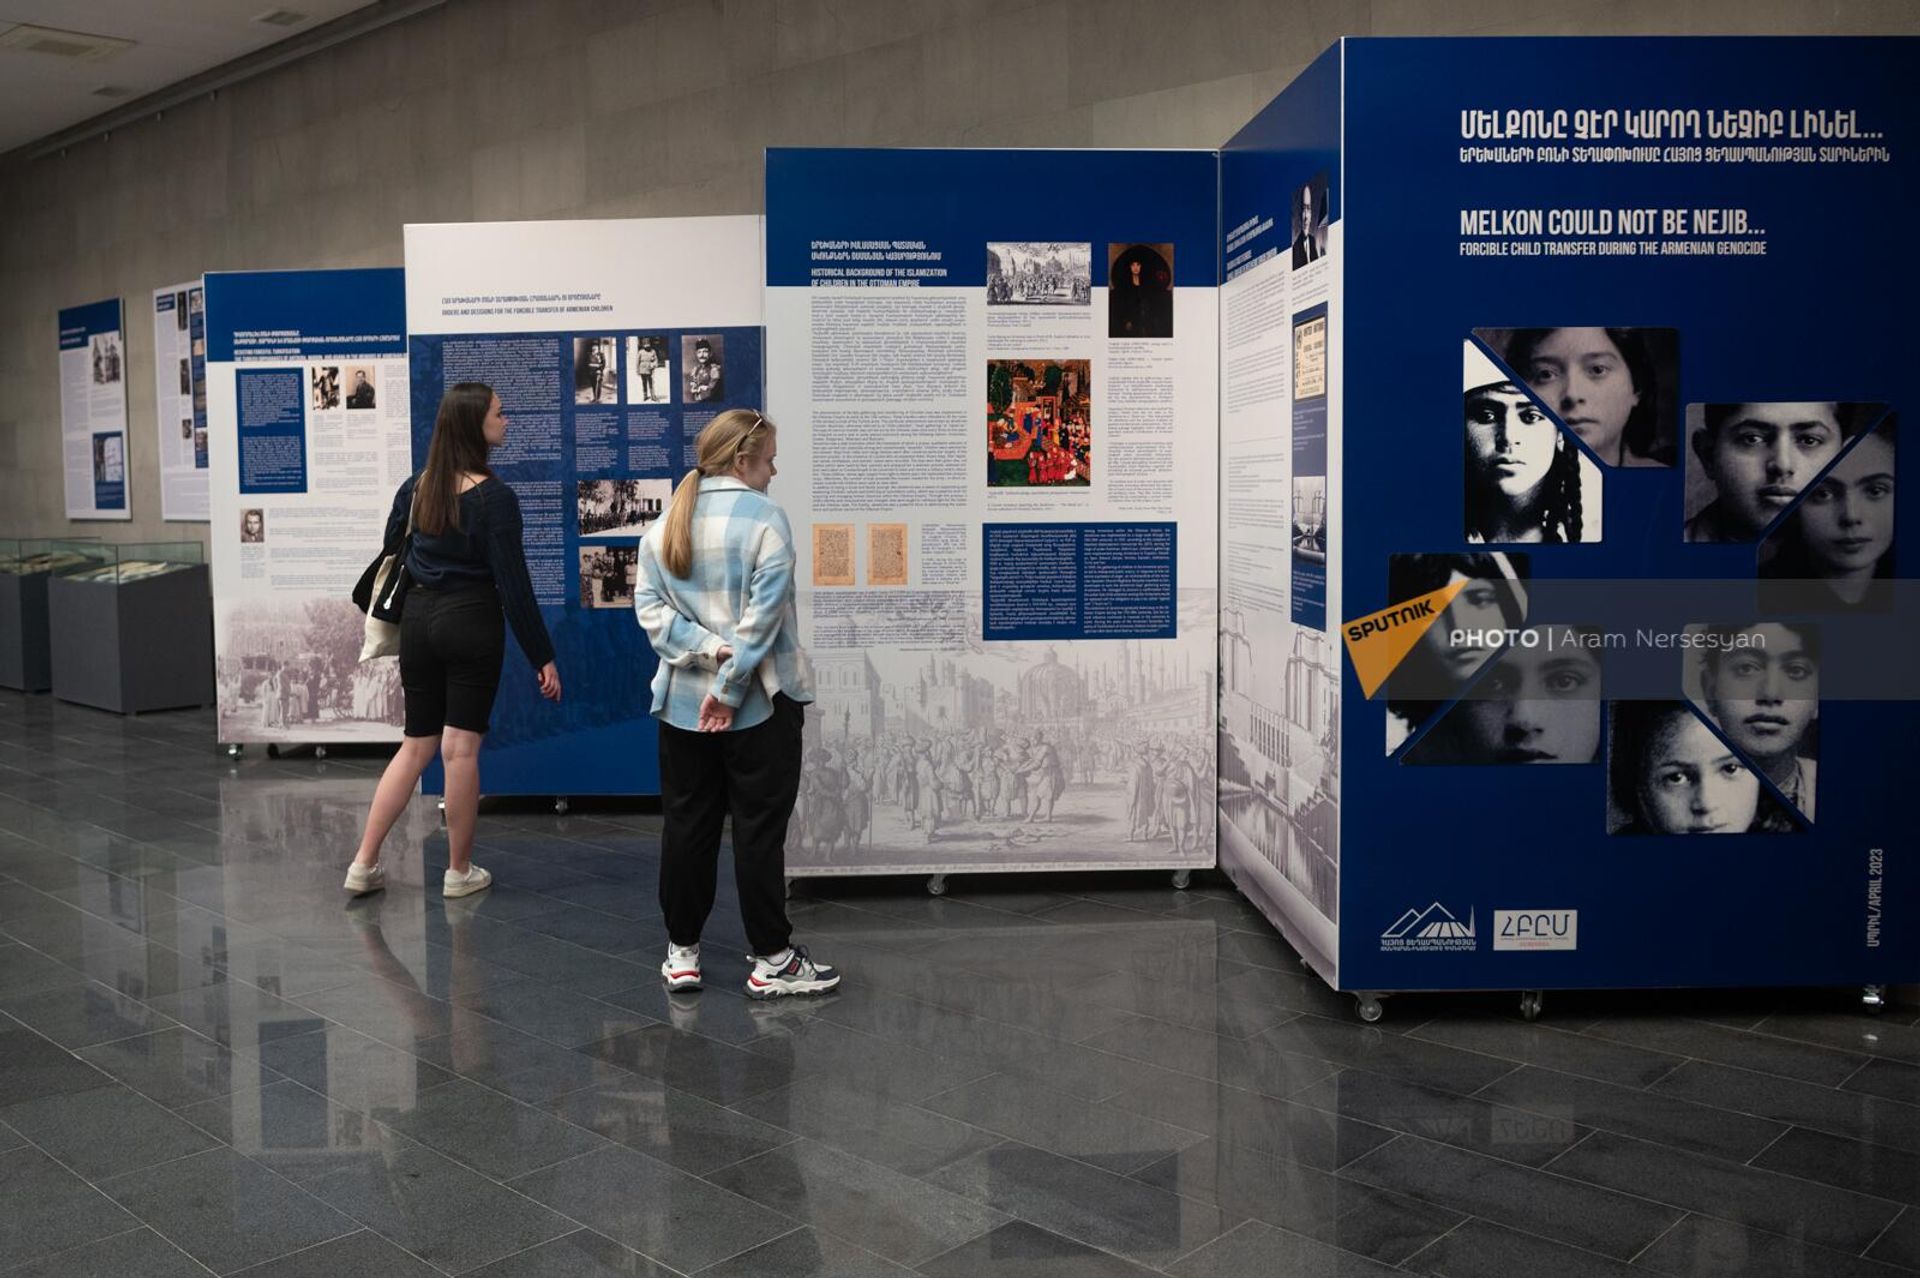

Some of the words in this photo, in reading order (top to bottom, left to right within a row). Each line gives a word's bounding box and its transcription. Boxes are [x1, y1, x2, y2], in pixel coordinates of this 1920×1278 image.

[1461, 109, 1568, 139] ՄԵԼՔՈՆԸ
[1624, 109, 1702, 139] ԿԱՐՈՂ
[1707, 109, 1784, 139] ՆԵՋԻԲ
[1460, 146, 1535, 163] ԵՐԵԽԱՆԵՐԻ
[1537, 146, 1570, 163] ԲՌՆԻ
[1572, 146, 1661, 163] ՏԵՂԱՓՈԽՈՒՄԸ
[1663, 146, 1702, 163] ՀԱՅՈՑ
[1705, 146, 1817, 163] ՑԵՂԱՍՊԱՆՈՒԹՅԱՆ
[1819, 146, 1891, 163] ՏԱՐԻՆԵՐԻՆ
[1460, 209, 1543, 236] MELKON
[1548, 209, 1613, 236] COULD
[1618, 209, 1658, 236] NOT
[1662, 209, 1688, 236] BE
[1693, 209, 1766, 236] NEJIB...
[1460, 241, 1509, 256] FORCIBLE
[1510, 241, 1541, 256] CHILD
[1543, 241, 1597, 256] TRANSFER
[1598, 241, 1637, 256] DURING
[1638, 241, 1659, 256] THE
[1660, 241, 1715, 256] ARMENIAN
[1717, 241, 1767, 256] GENOCIDE
[1869, 849, 1883, 876] 2023
